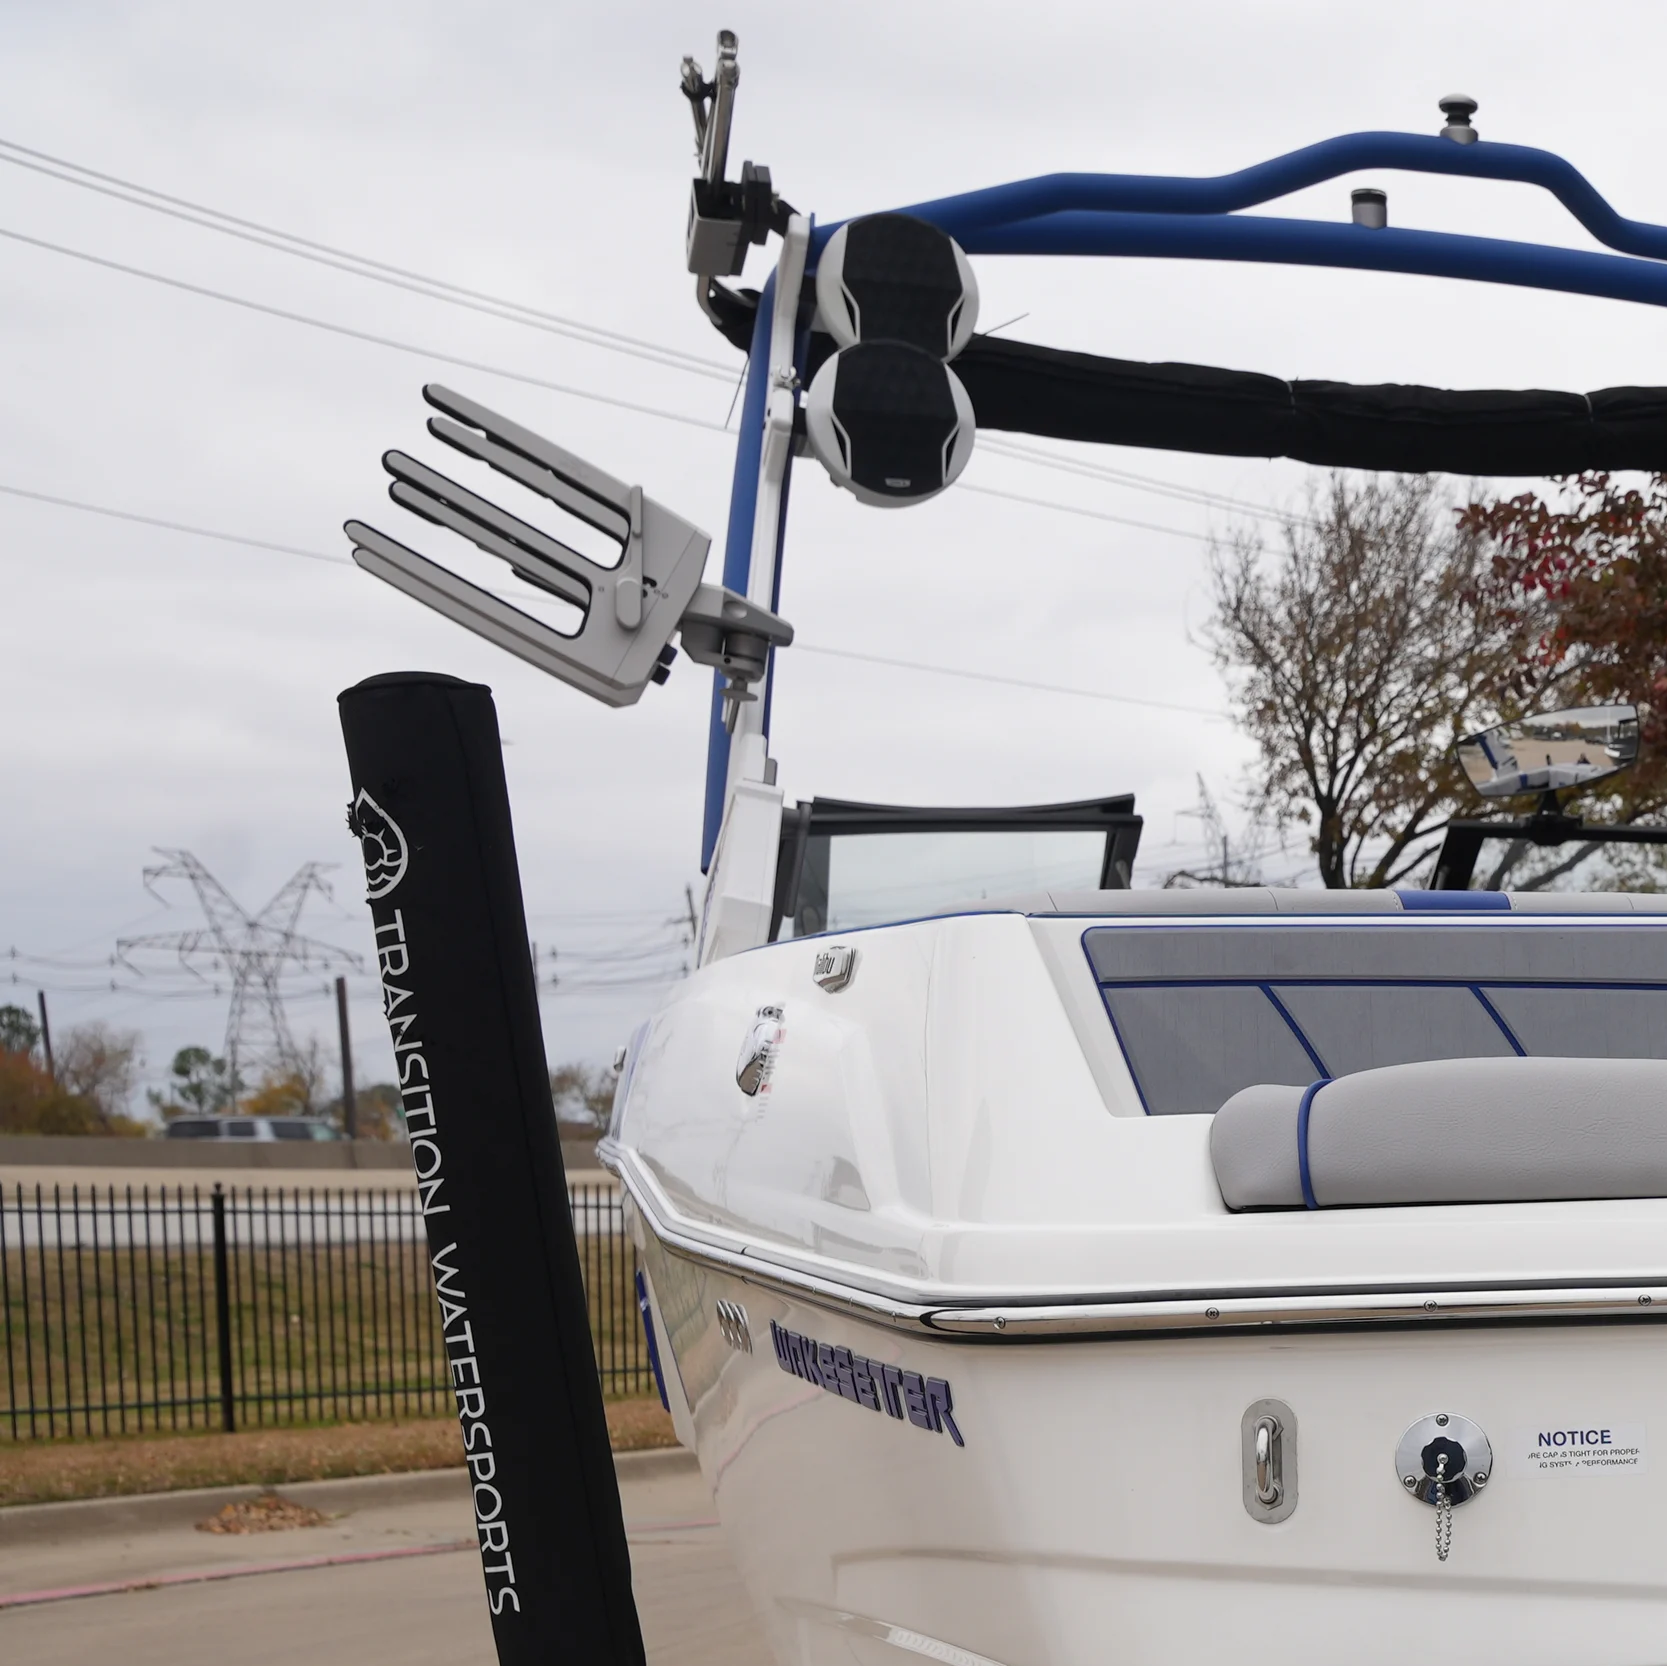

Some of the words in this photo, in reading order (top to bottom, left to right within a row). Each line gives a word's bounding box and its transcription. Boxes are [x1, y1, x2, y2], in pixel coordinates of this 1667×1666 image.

[375, 909, 450, 1215] TRANSITION
[432, 1242, 520, 1615] WATERSPORTS
[769, 1318, 965, 1448] WAKESETTER
[1538, 1430, 1612, 1447] NOTICE
[1542, 1451, 1558, 1459] CAP
[1569, 1449, 1590, 1458] TIGHT
[1592, 1449, 1608, 1457] FOR
